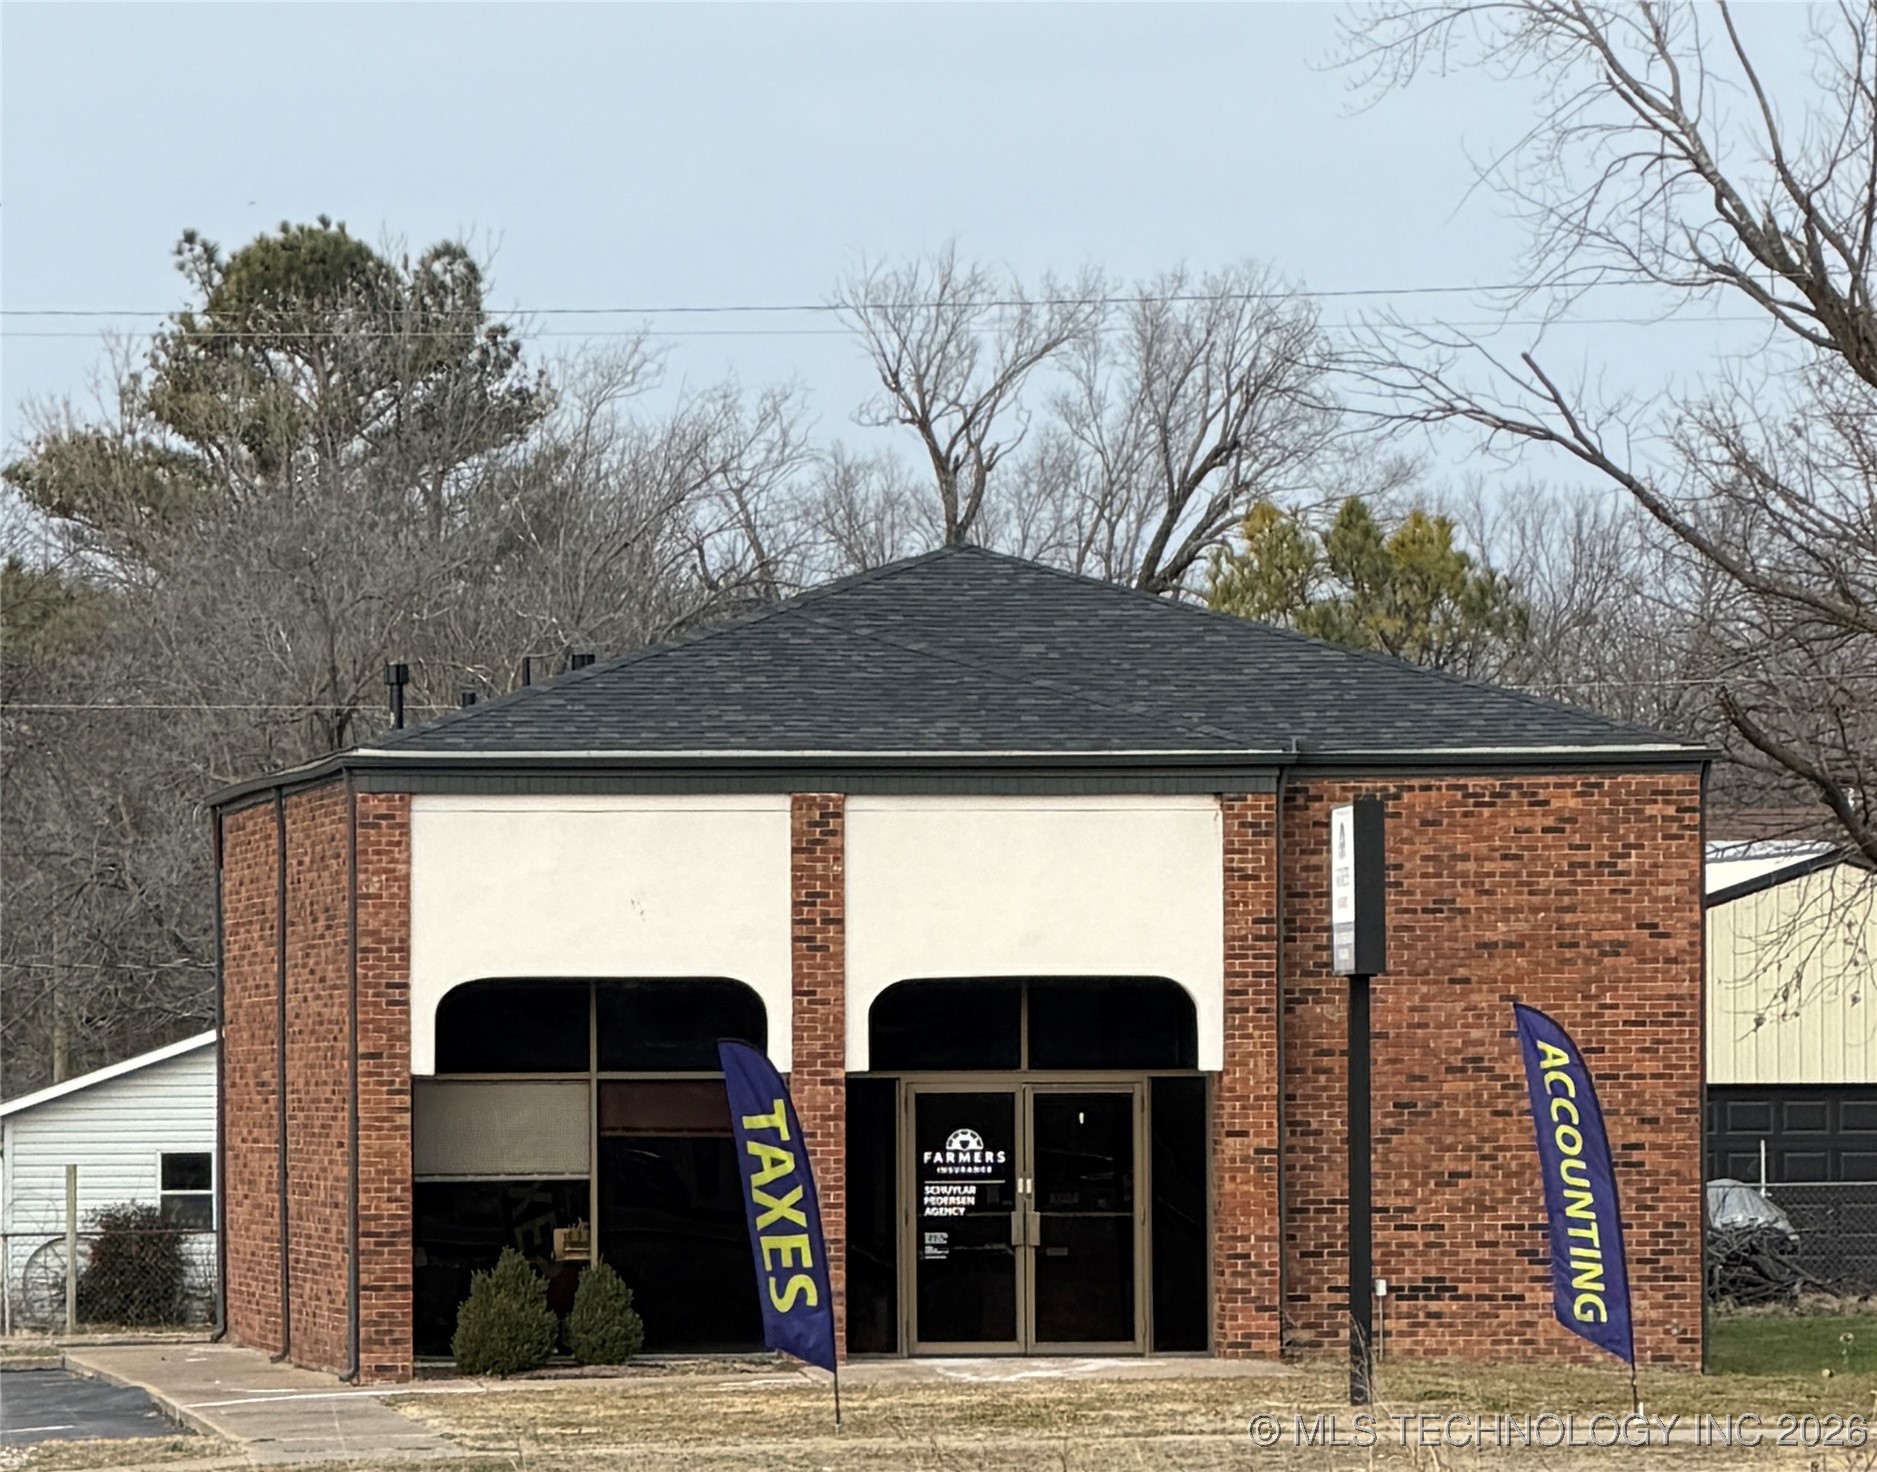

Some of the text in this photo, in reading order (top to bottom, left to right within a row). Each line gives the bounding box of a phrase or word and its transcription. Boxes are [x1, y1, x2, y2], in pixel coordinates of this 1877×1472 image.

[923, 1151, 1006, 1164] FARMERS
[1537, 1039, 1608, 1323] ACCOUNTING
[742, 1098, 818, 1314] TAXES
[923, 1196, 976, 1206] PEDERSEN
[924, 1207, 966, 1217] AGENCY
